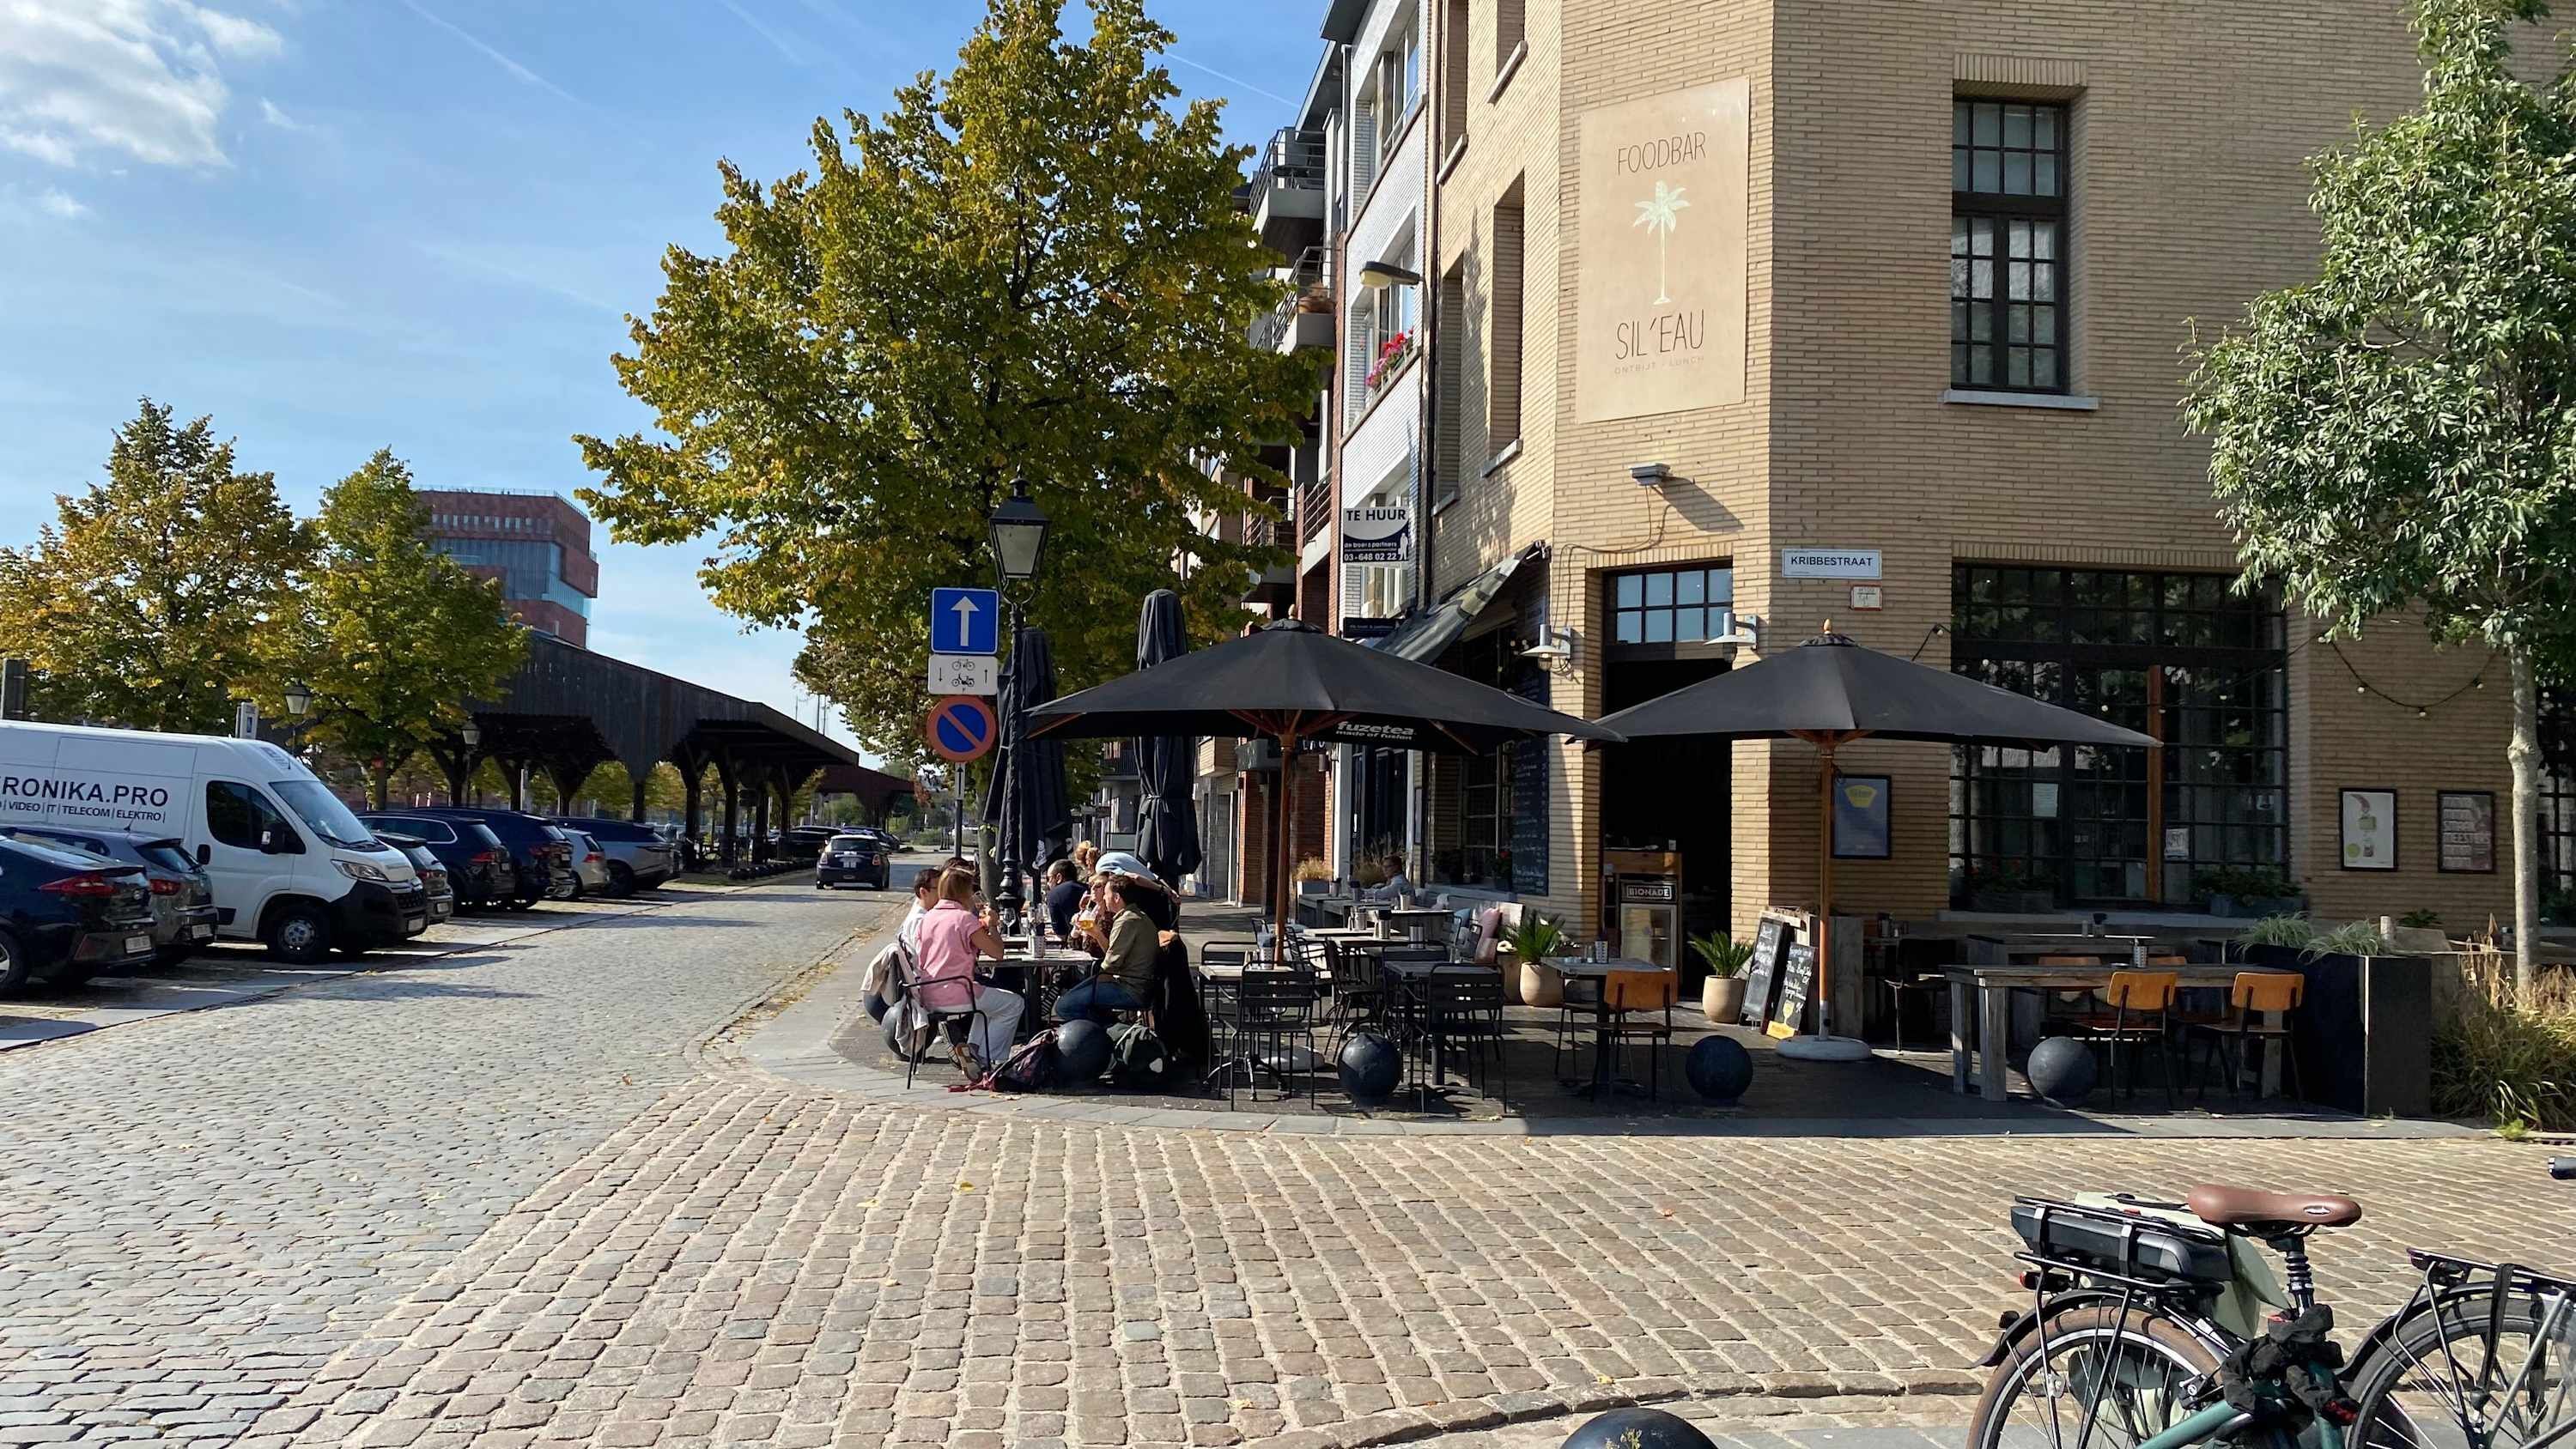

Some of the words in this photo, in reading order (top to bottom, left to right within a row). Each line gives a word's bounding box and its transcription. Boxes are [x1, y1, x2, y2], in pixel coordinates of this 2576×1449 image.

[1618, 131, 1706, 176] FOODBAR
[1346, 510, 1360, 521] TE
[1366, 509, 1406, 521] HUUR
[1387, 552, 1397, 561] 22
[1791, 556, 1873, 567] KRIBBESTRAAT
[1338, 721, 1414, 735] fuzetea
[0, 776, 169, 807] RONIKA.PRO
[46, 804, 57, 813] IT
[62, 805, 111, 818] TELECOM
[116, 809, 161, 822] ELEKTRO
